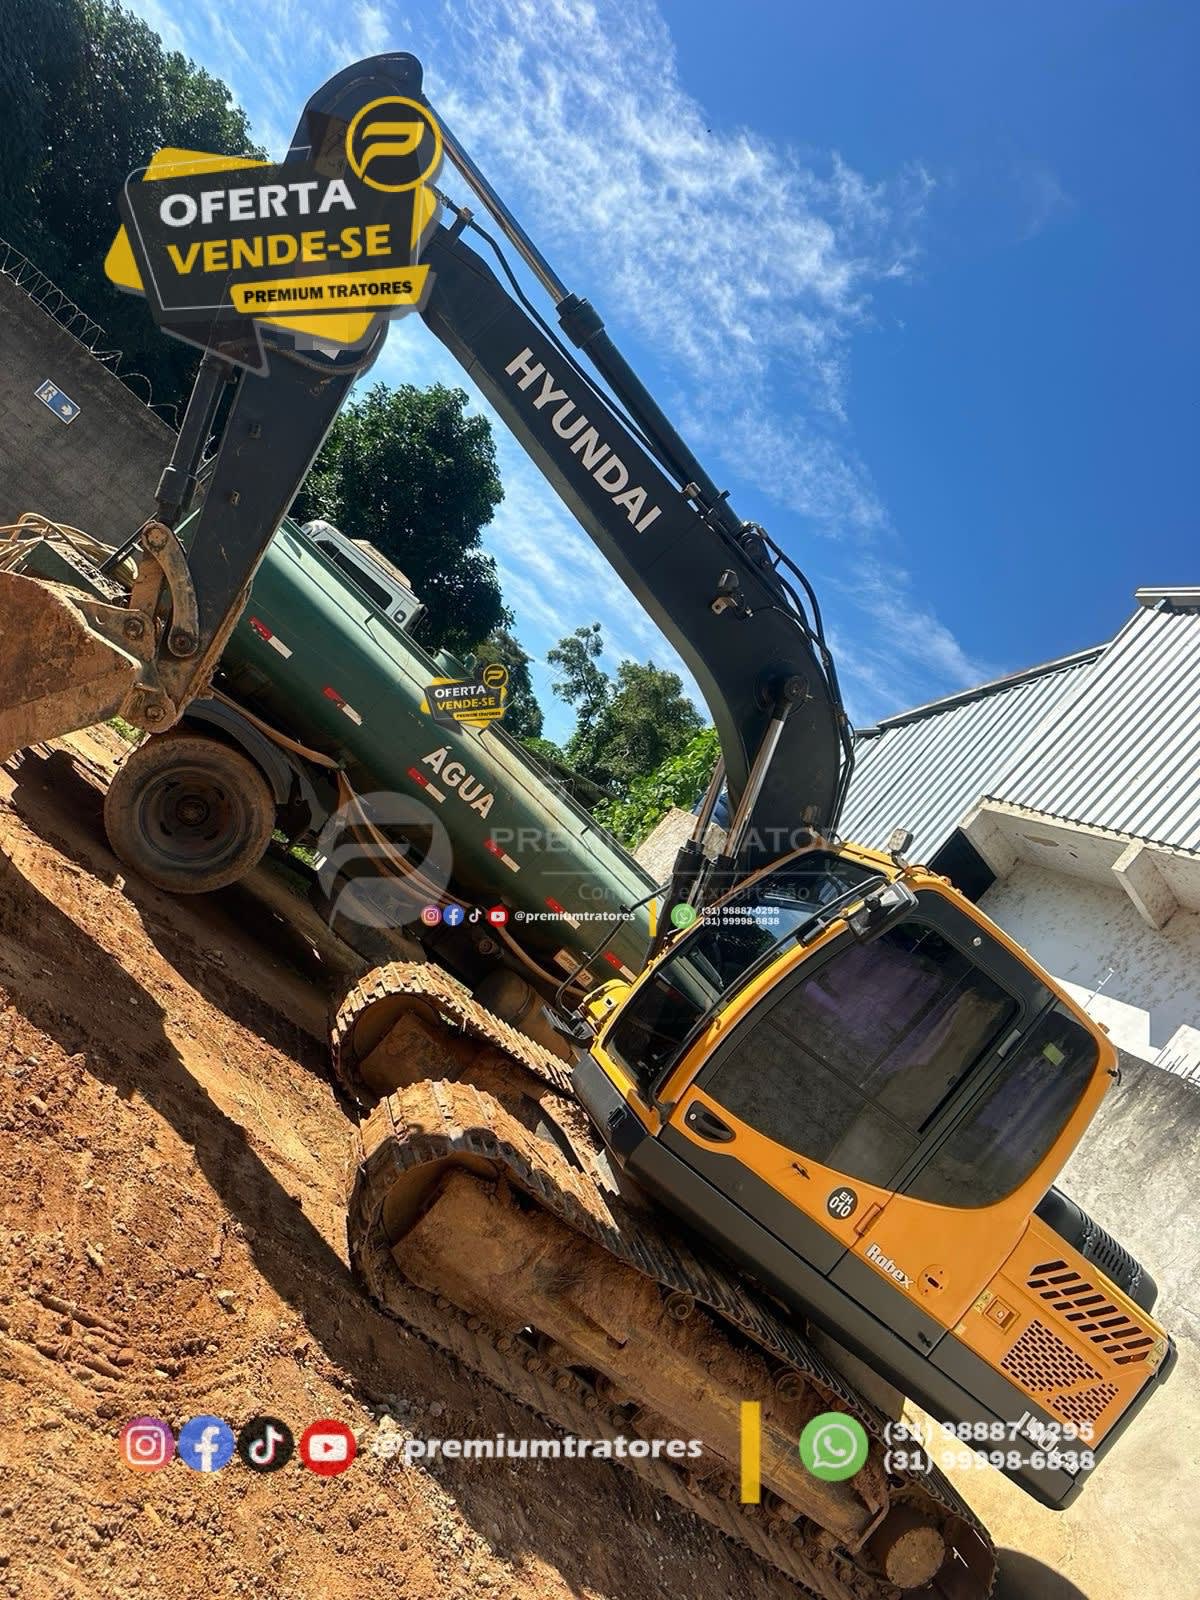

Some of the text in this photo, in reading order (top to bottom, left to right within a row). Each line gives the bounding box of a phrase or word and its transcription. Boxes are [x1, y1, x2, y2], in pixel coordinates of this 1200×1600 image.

[504, 347, 662, 534] HYUNDAI
[421, 746, 495, 819] ÁGUA
[829, 1196, 851, 1217] 010
[839, 1191, 854, 1205] EH
[866, 1243, 914, 1289] Robex
